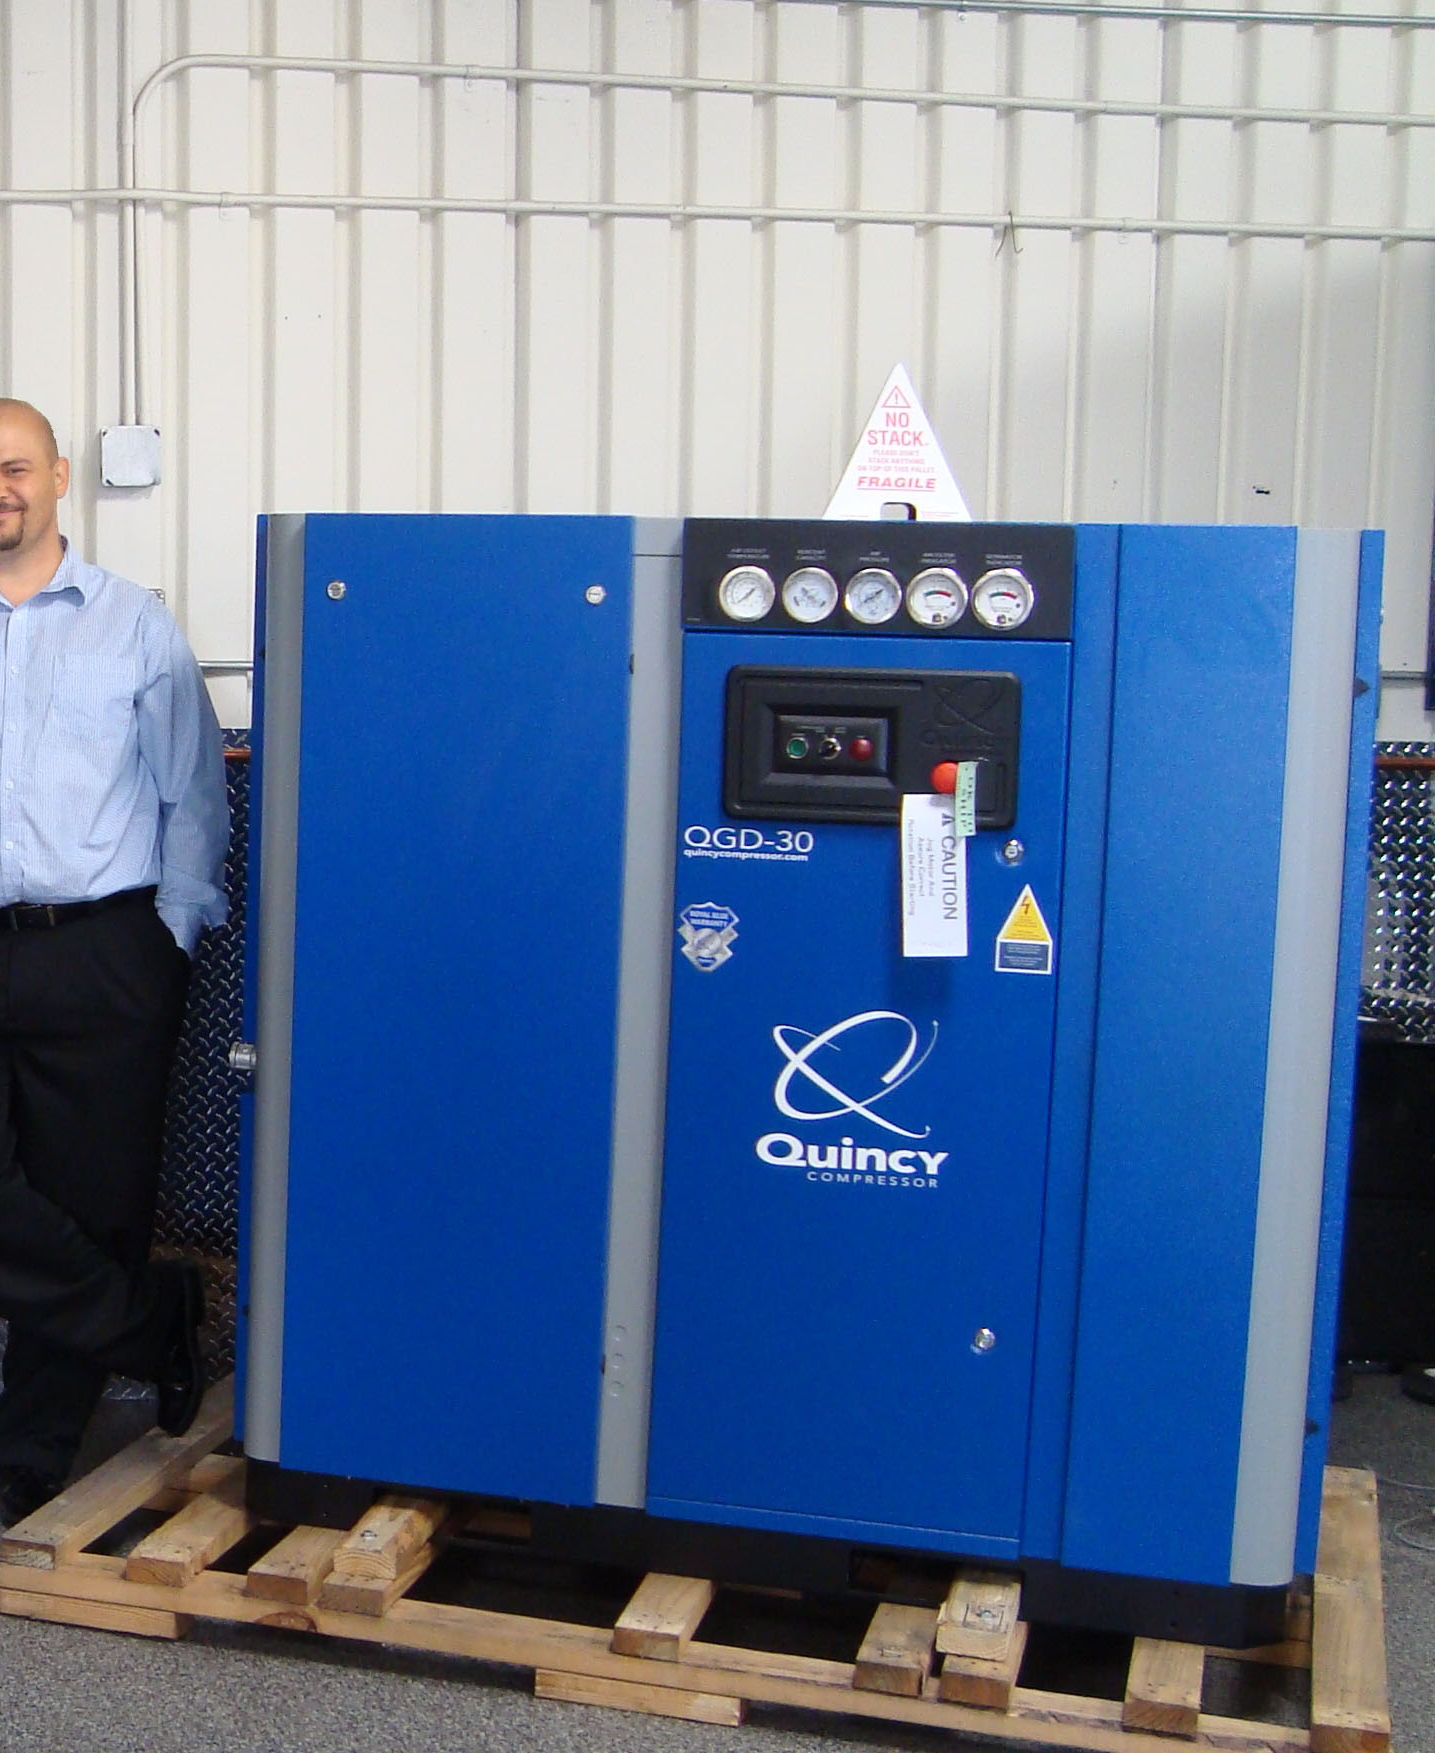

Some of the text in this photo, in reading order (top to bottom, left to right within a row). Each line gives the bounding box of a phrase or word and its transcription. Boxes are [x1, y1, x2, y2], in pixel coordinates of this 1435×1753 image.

[885, 411, 910, 428] NO
[857, 476, 938, 489] FRAGILE
[683, 825, 815, 853] QGD-30
[683, 848, 810, 862] quincycompressor.com
[941, 835, 959, 920] CAUTION
[690, 918, 729, 928] WARRANTY
[806, 1170, 939, 1188] COMPRESSOR
